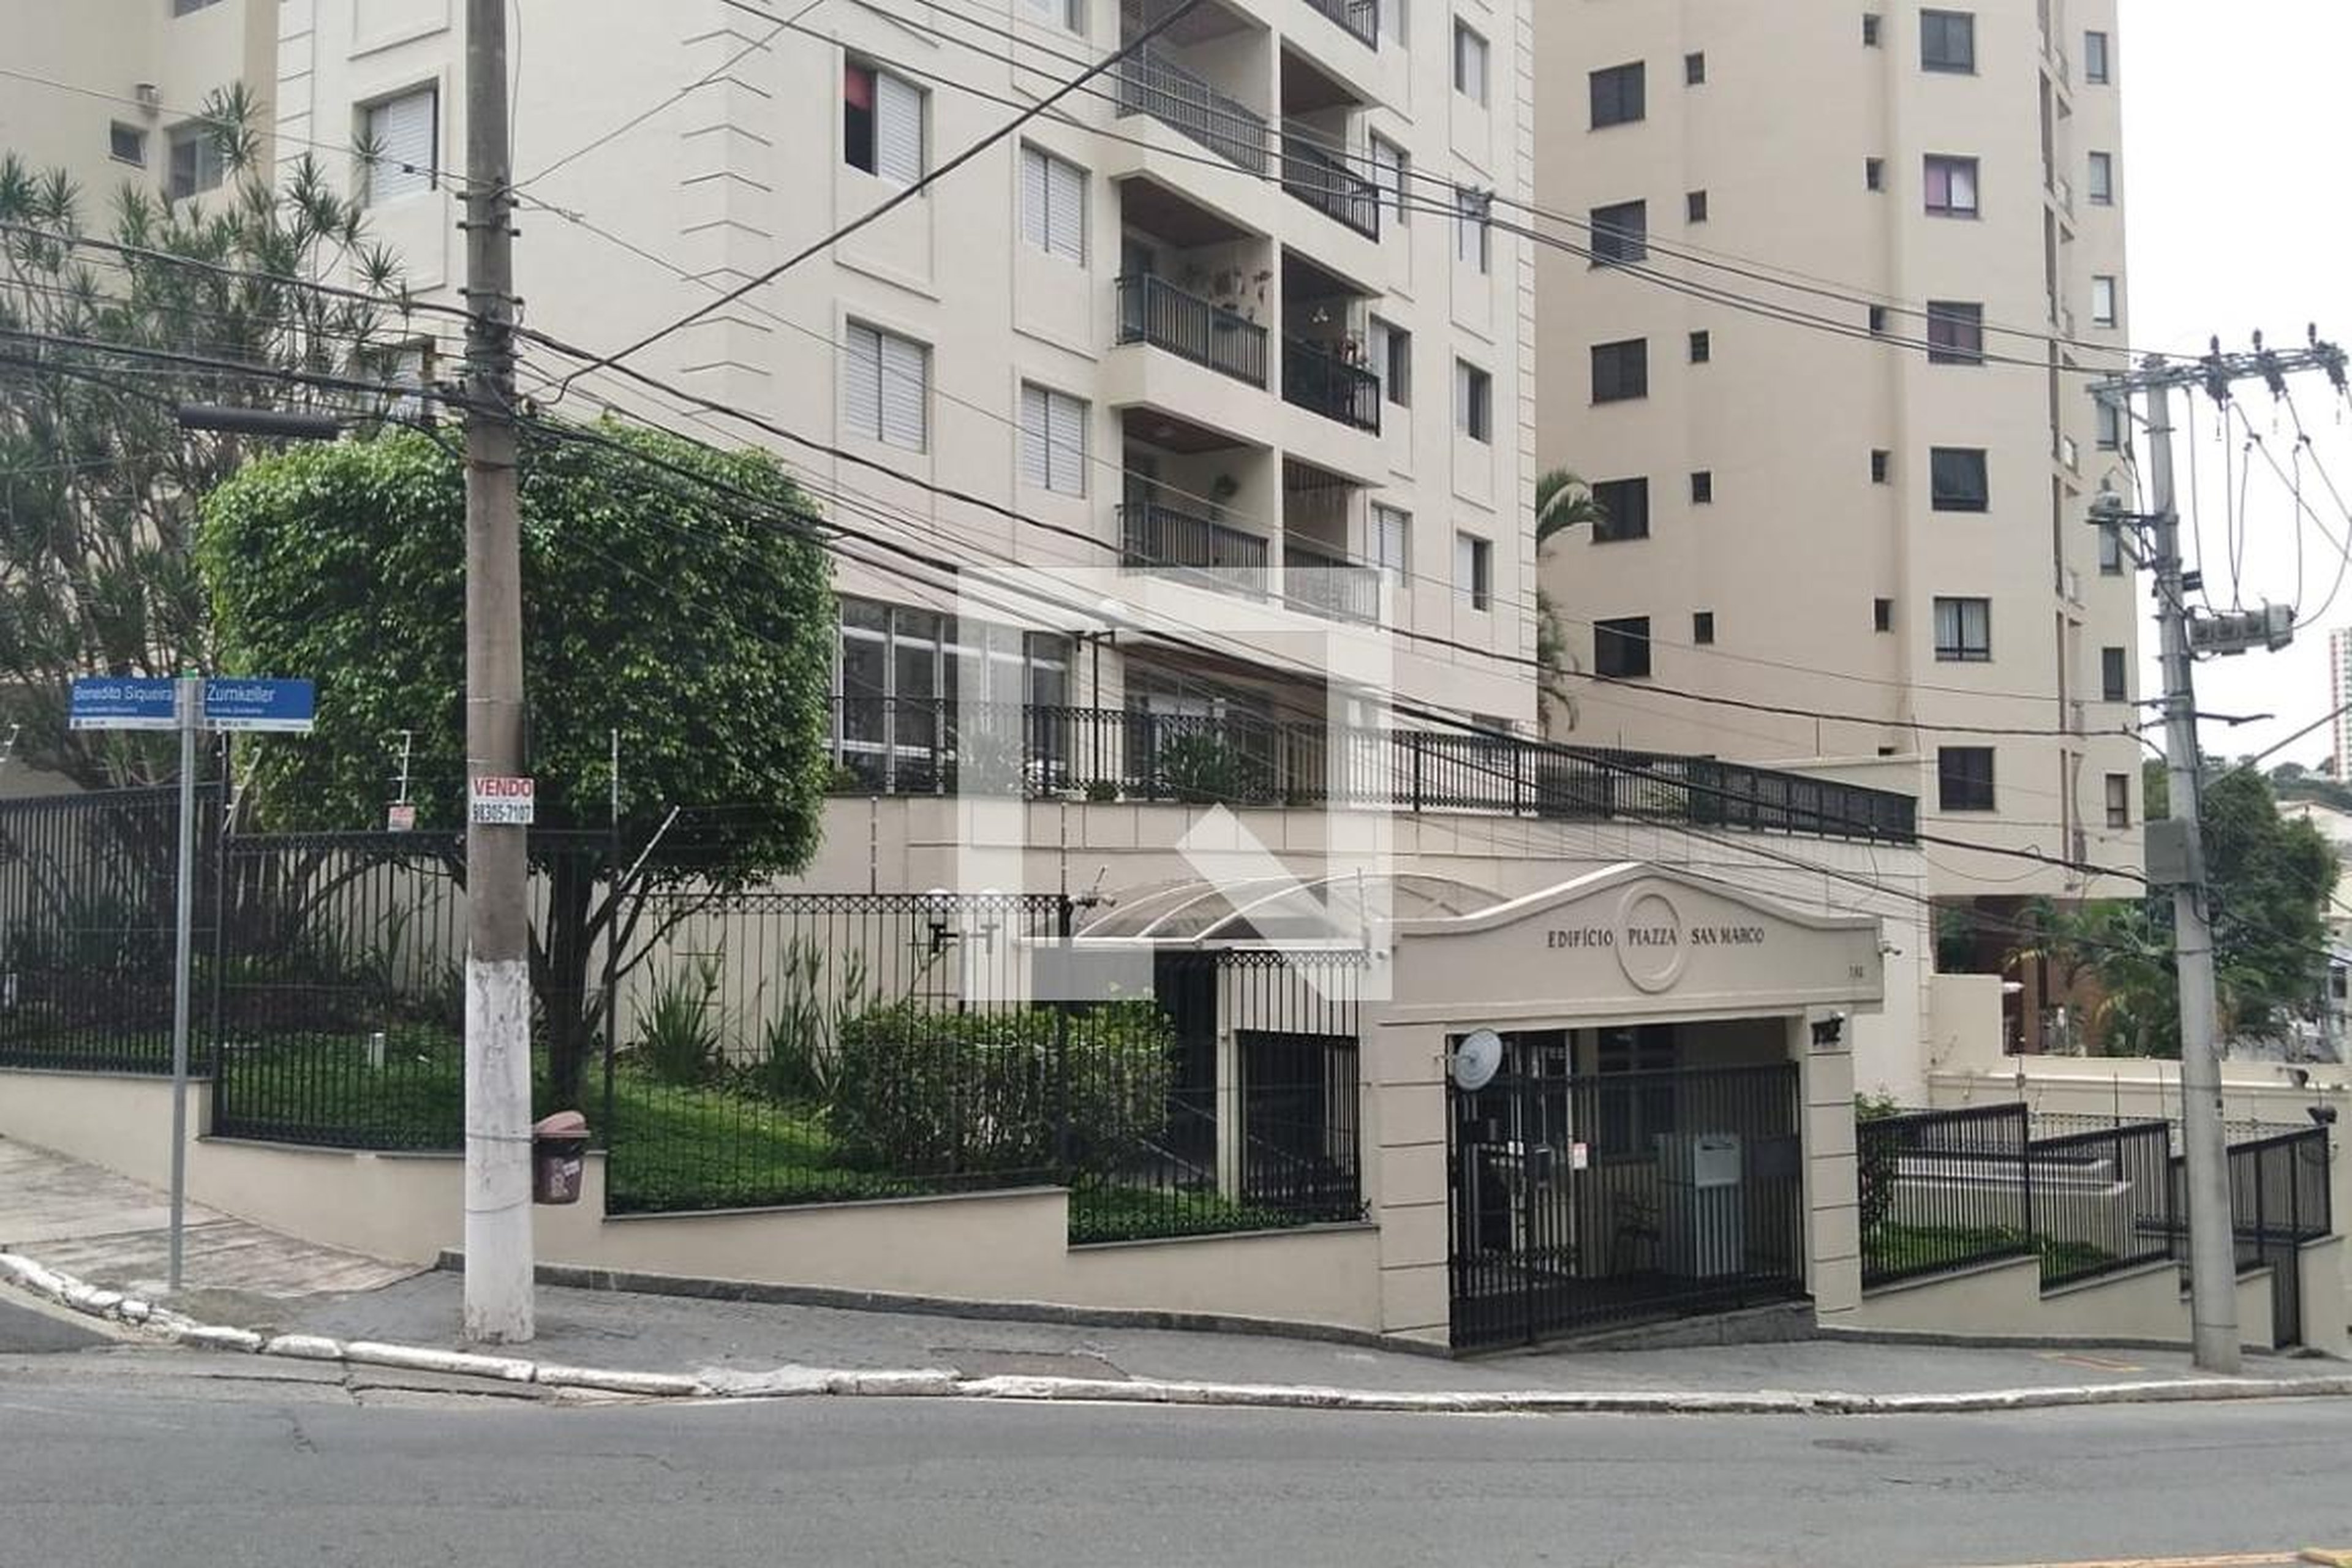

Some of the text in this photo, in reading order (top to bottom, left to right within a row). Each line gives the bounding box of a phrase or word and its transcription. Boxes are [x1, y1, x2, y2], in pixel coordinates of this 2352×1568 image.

[206, 684, 276, 702] Zumkeller
[474, 778, 531, 797] VENDO
[1548, 927, 1765, 948] EDIFÍCIO PIAZZA SAN MARCO
